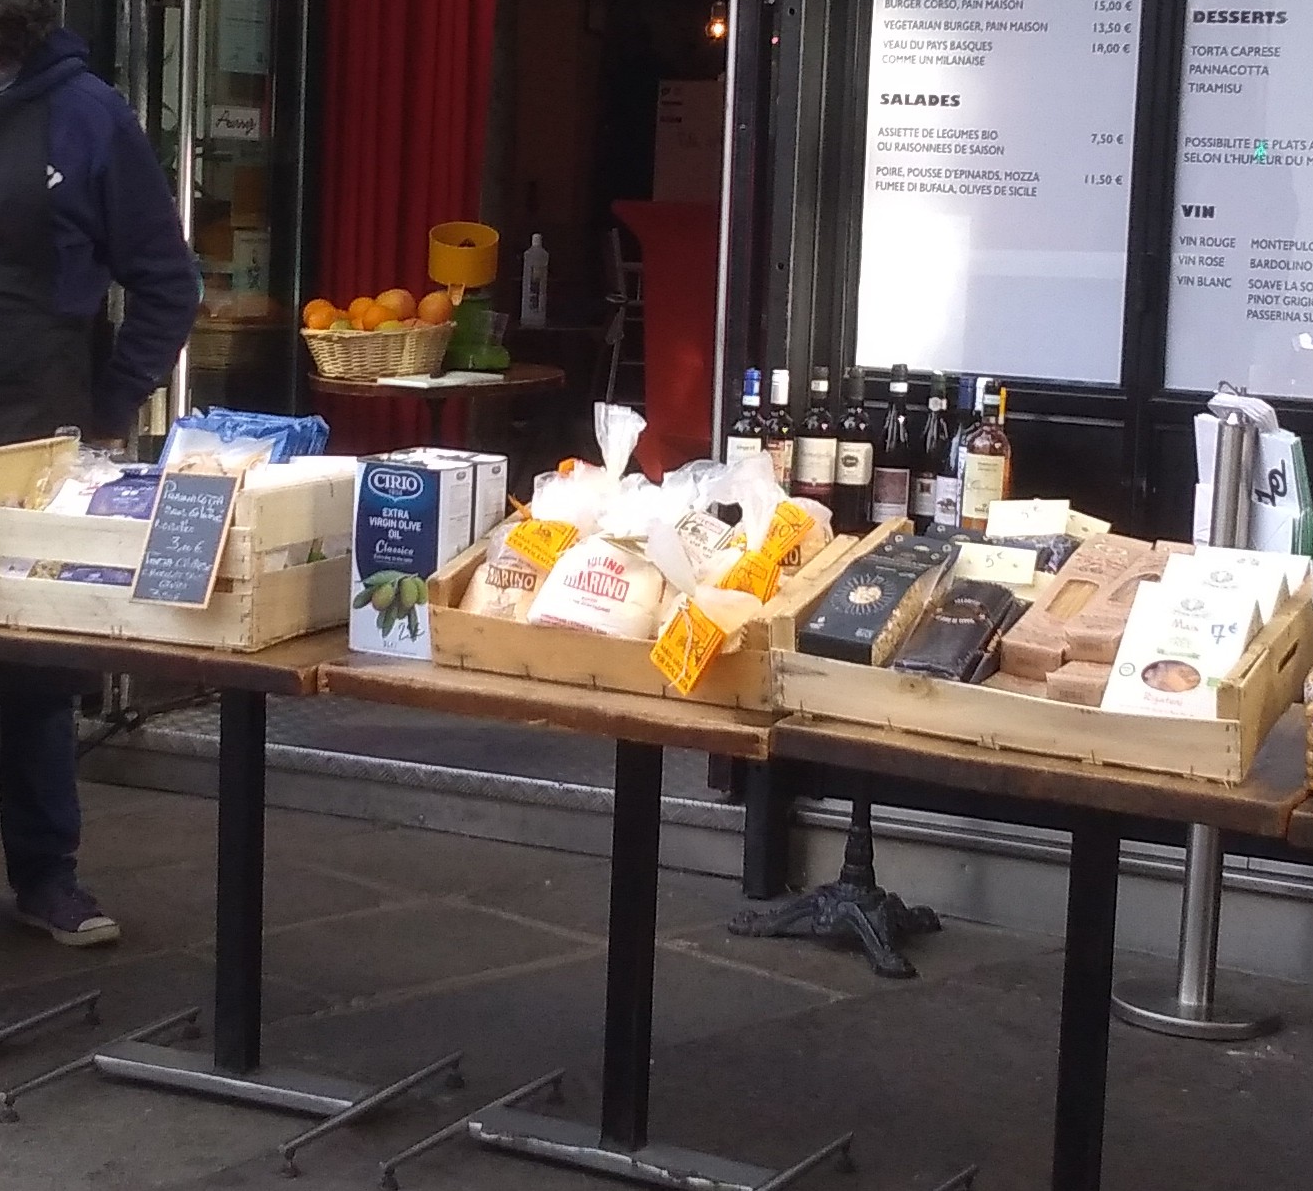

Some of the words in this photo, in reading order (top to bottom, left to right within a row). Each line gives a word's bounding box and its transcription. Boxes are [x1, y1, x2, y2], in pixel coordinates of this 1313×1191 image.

[885, 0, 921, 9] BURGER
[923, 0, 959, 9] CORSO,
[961, 0, 983, 9] PAIN
[984, 0, 1023, 9] MAISON
[1193, 11, 1287, 24] DESSERTS
[1190, 46, 1229, 56] TORTA
[1231, 47, 1281, 57] CAPRESE
[1188, 83, 1242, 93] TIRAMISU
[880, 94, 961, 106] SALADES
[878, 128, 920, 138] ASSIETTE
[923, 129, 935, 139] DE
[937, 129, 980, 140] LEGUMES
[981, 130, 998, 140] BIO
[1254, 140, 1268, 149] DE
[1273, 140, 1306, 151] PLATS
[1184, 153, 1224, 164] SELON
[1226, 154, 1285, 166] L'HUMEUR
[1288, 155, 1307, 166] DU
[1182, 205, 1215, 218] VIN
[1179, 237, 1197, 247] VIN
[1199, 237, 1235, 248] ROUGE
[1178, 256, 1196, 266] VIN
[1198, 256, 1224, 267] ROSE
[1250, 259, 1313, 272] BARDOLINO
[1177, 276, 1194, 287] VIN
[1196, 276, 1231, 288] BLANC
[1248, 279, 1283, 291] SOAVE
[1286, 280, 1299, 292] LA
[1247, 295, 1279, 306] PINOT
[1247, 310, 1304, 323] PASSERINA
[373, 473, 418, 492] CIRIO
[382, 507, 409, 519] EXTRA
[369, 516, 397, 527] VIRGIN
[398, 519, 422, 531] OLIVE
[388, 529, 403, 540] OIL
